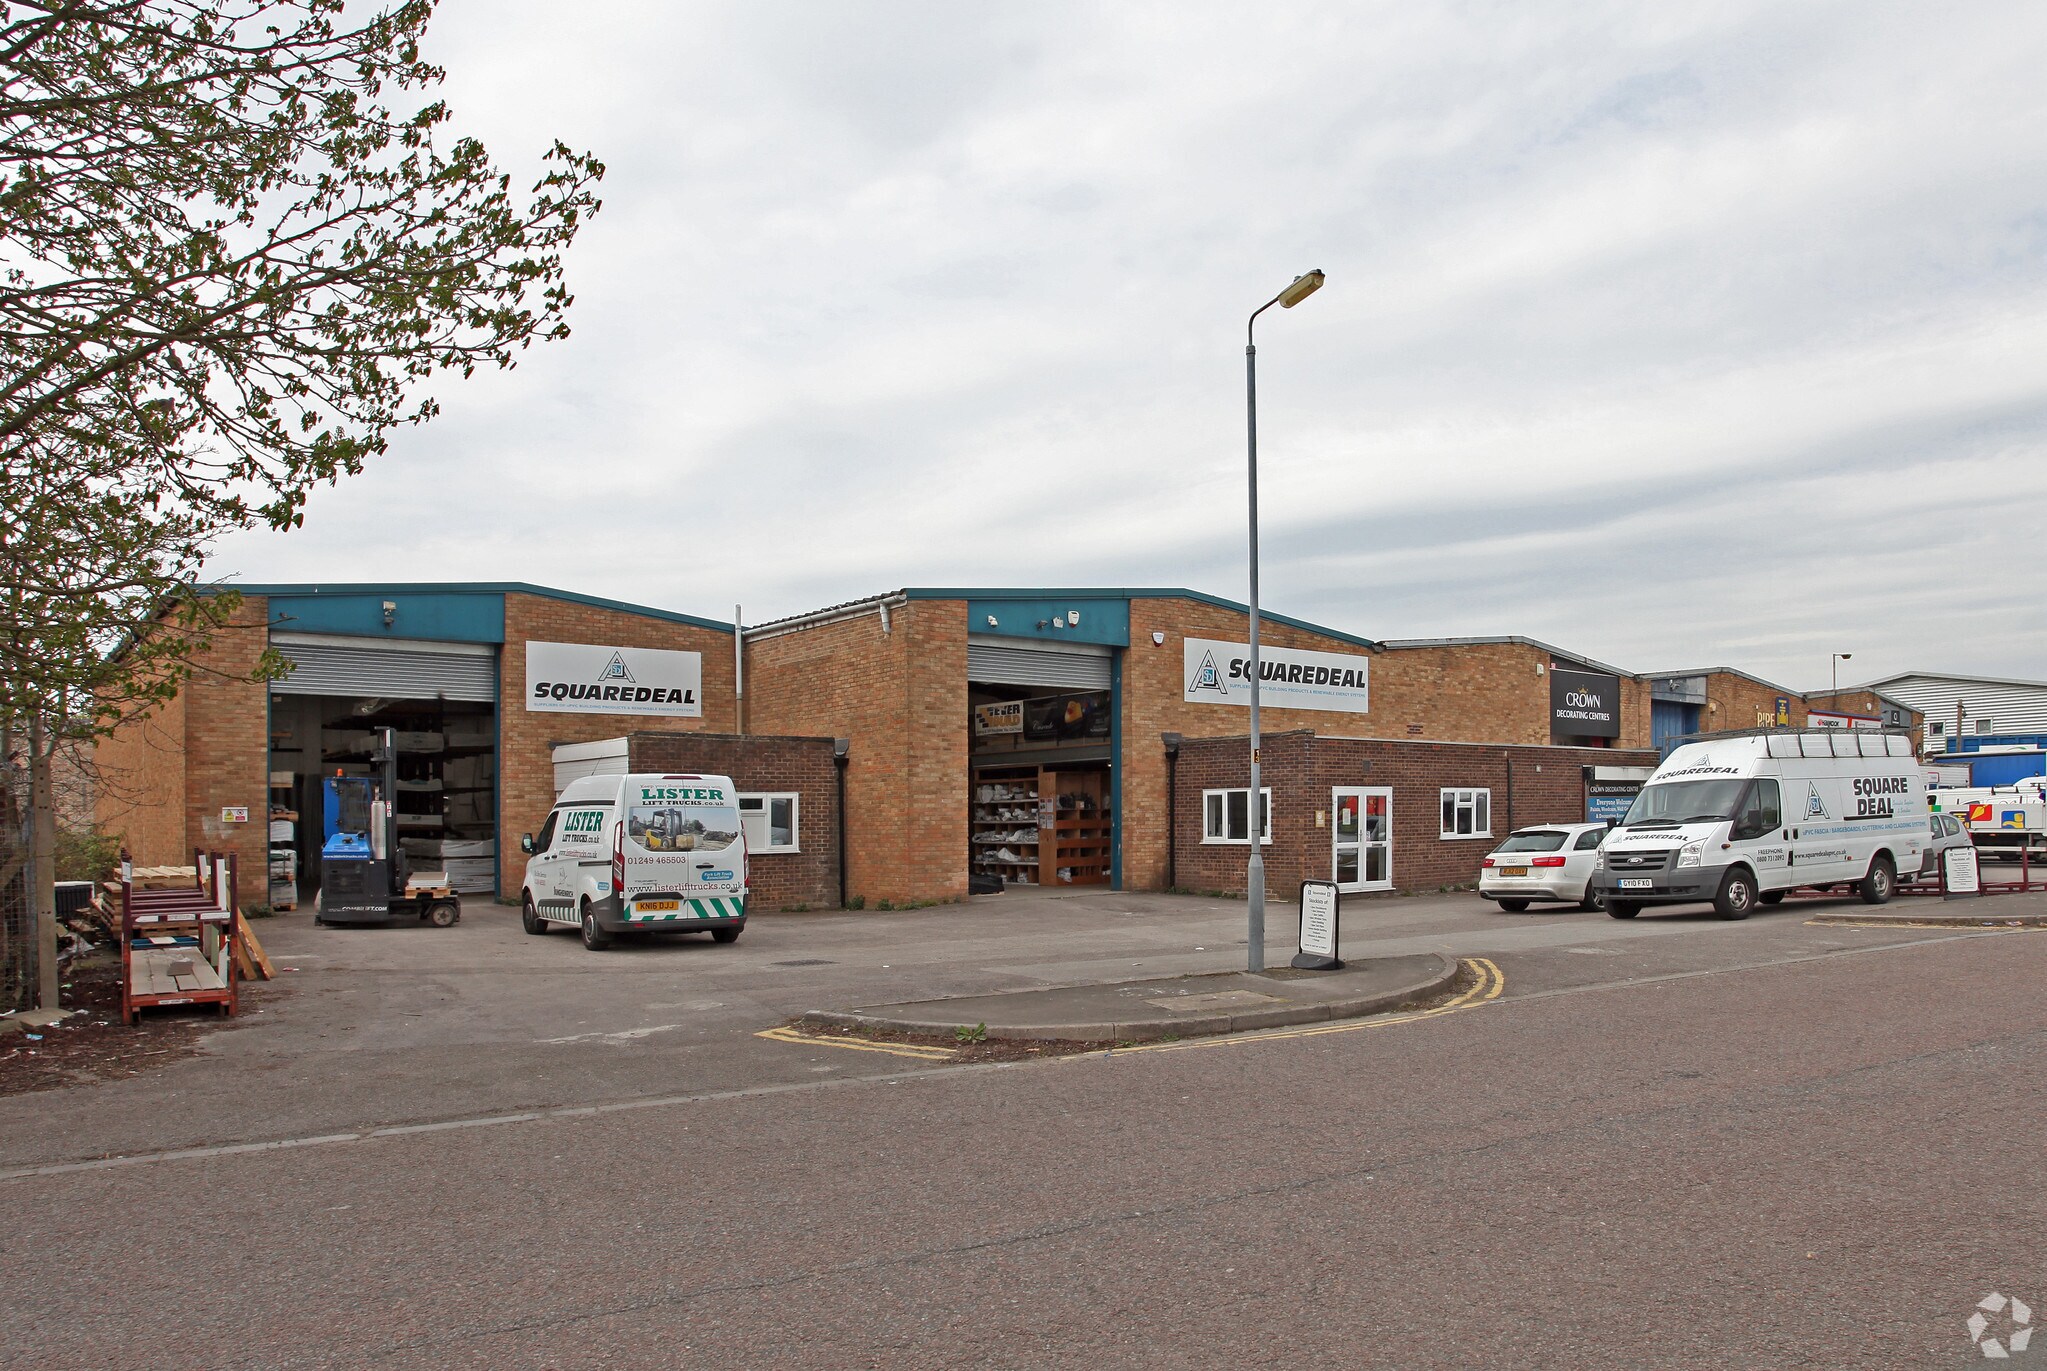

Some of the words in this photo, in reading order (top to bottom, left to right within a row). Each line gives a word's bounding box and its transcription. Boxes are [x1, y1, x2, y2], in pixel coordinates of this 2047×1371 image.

[534, 682, 695, 704] SQUAREDEAL
[1565, 692, 1601, 708] CROWN
[1556, 709, 1588, 720] DECORATING
[1588, 712, 1610, 721] CENTRES
[1757, 712, 1775, 728] PIPE
[1654, 766, 1740, 781] SQUAREDEAL
[1590, 785, 1604, 793] CROWN
[1853, 777, 1908, 797] SQUARE
[641, 788, 724, 800] LISTER
[1596, 798, 1616, 807] Everyone
[1857, 798, 1894, 816] DEAL
[564, 811, 604, 832] LISTER
[1862, 824, 1884, 832] GUTTERING
[562, 834, 571, 842] LIFT
[1622, 834, 1689, 842] SQUAREDEAL
[627, 857, 654, 865] 01249
[656, 856, 686, 864] 465503
[1756, 855, 1767, 863] 0800
[627, 882, 743, 893] www.listerlifttrucks.co.uk
[1623, 879, 1637, 887] GY10
[640, 902, 657, 910] KN16
[659, 901, 675, 909] DJJ
